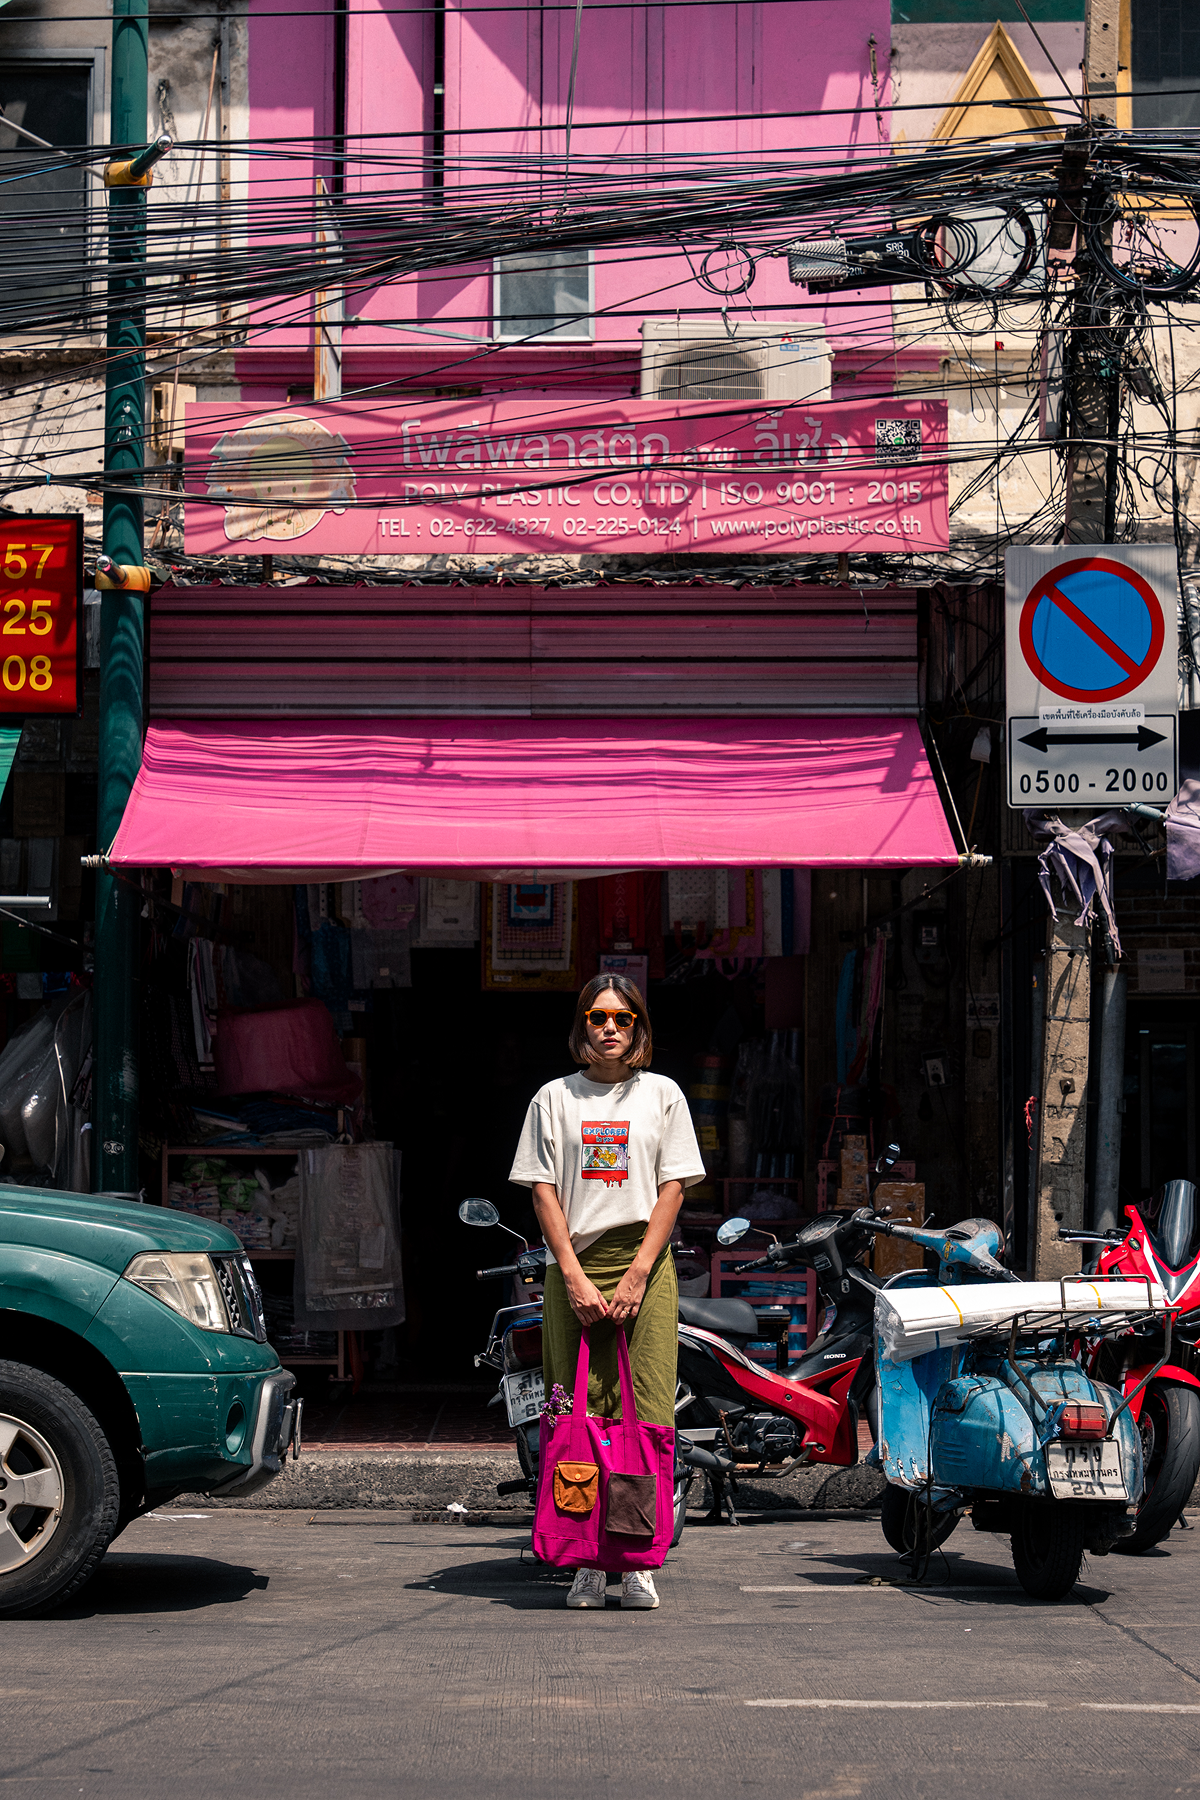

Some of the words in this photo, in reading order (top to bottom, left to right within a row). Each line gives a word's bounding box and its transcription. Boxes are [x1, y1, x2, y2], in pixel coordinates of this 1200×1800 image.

[404, 483, 468, 506] POLY
[481, 483, 581, 506] PLASTIC
[720, 482, 763, 505] ISO
[776, 481, 836, 505] 9001
[867, 481, 922, 504] 2015
[377, 518, 411, 536] TEL
[429, 518, 555, 539] 02-622-4327,
[562, 517, 682, 536] 02-225-0124
[711, 515, 922, 540] www.polyplastic.co.th
[0, 543, 54, 580] 57
[0, 599, 53, 636] 25
[2, 655, 53, 692] 08
[583, 1127, 627, 1136] EXPLORER
[0, 1389, 64, 1430] TONE
